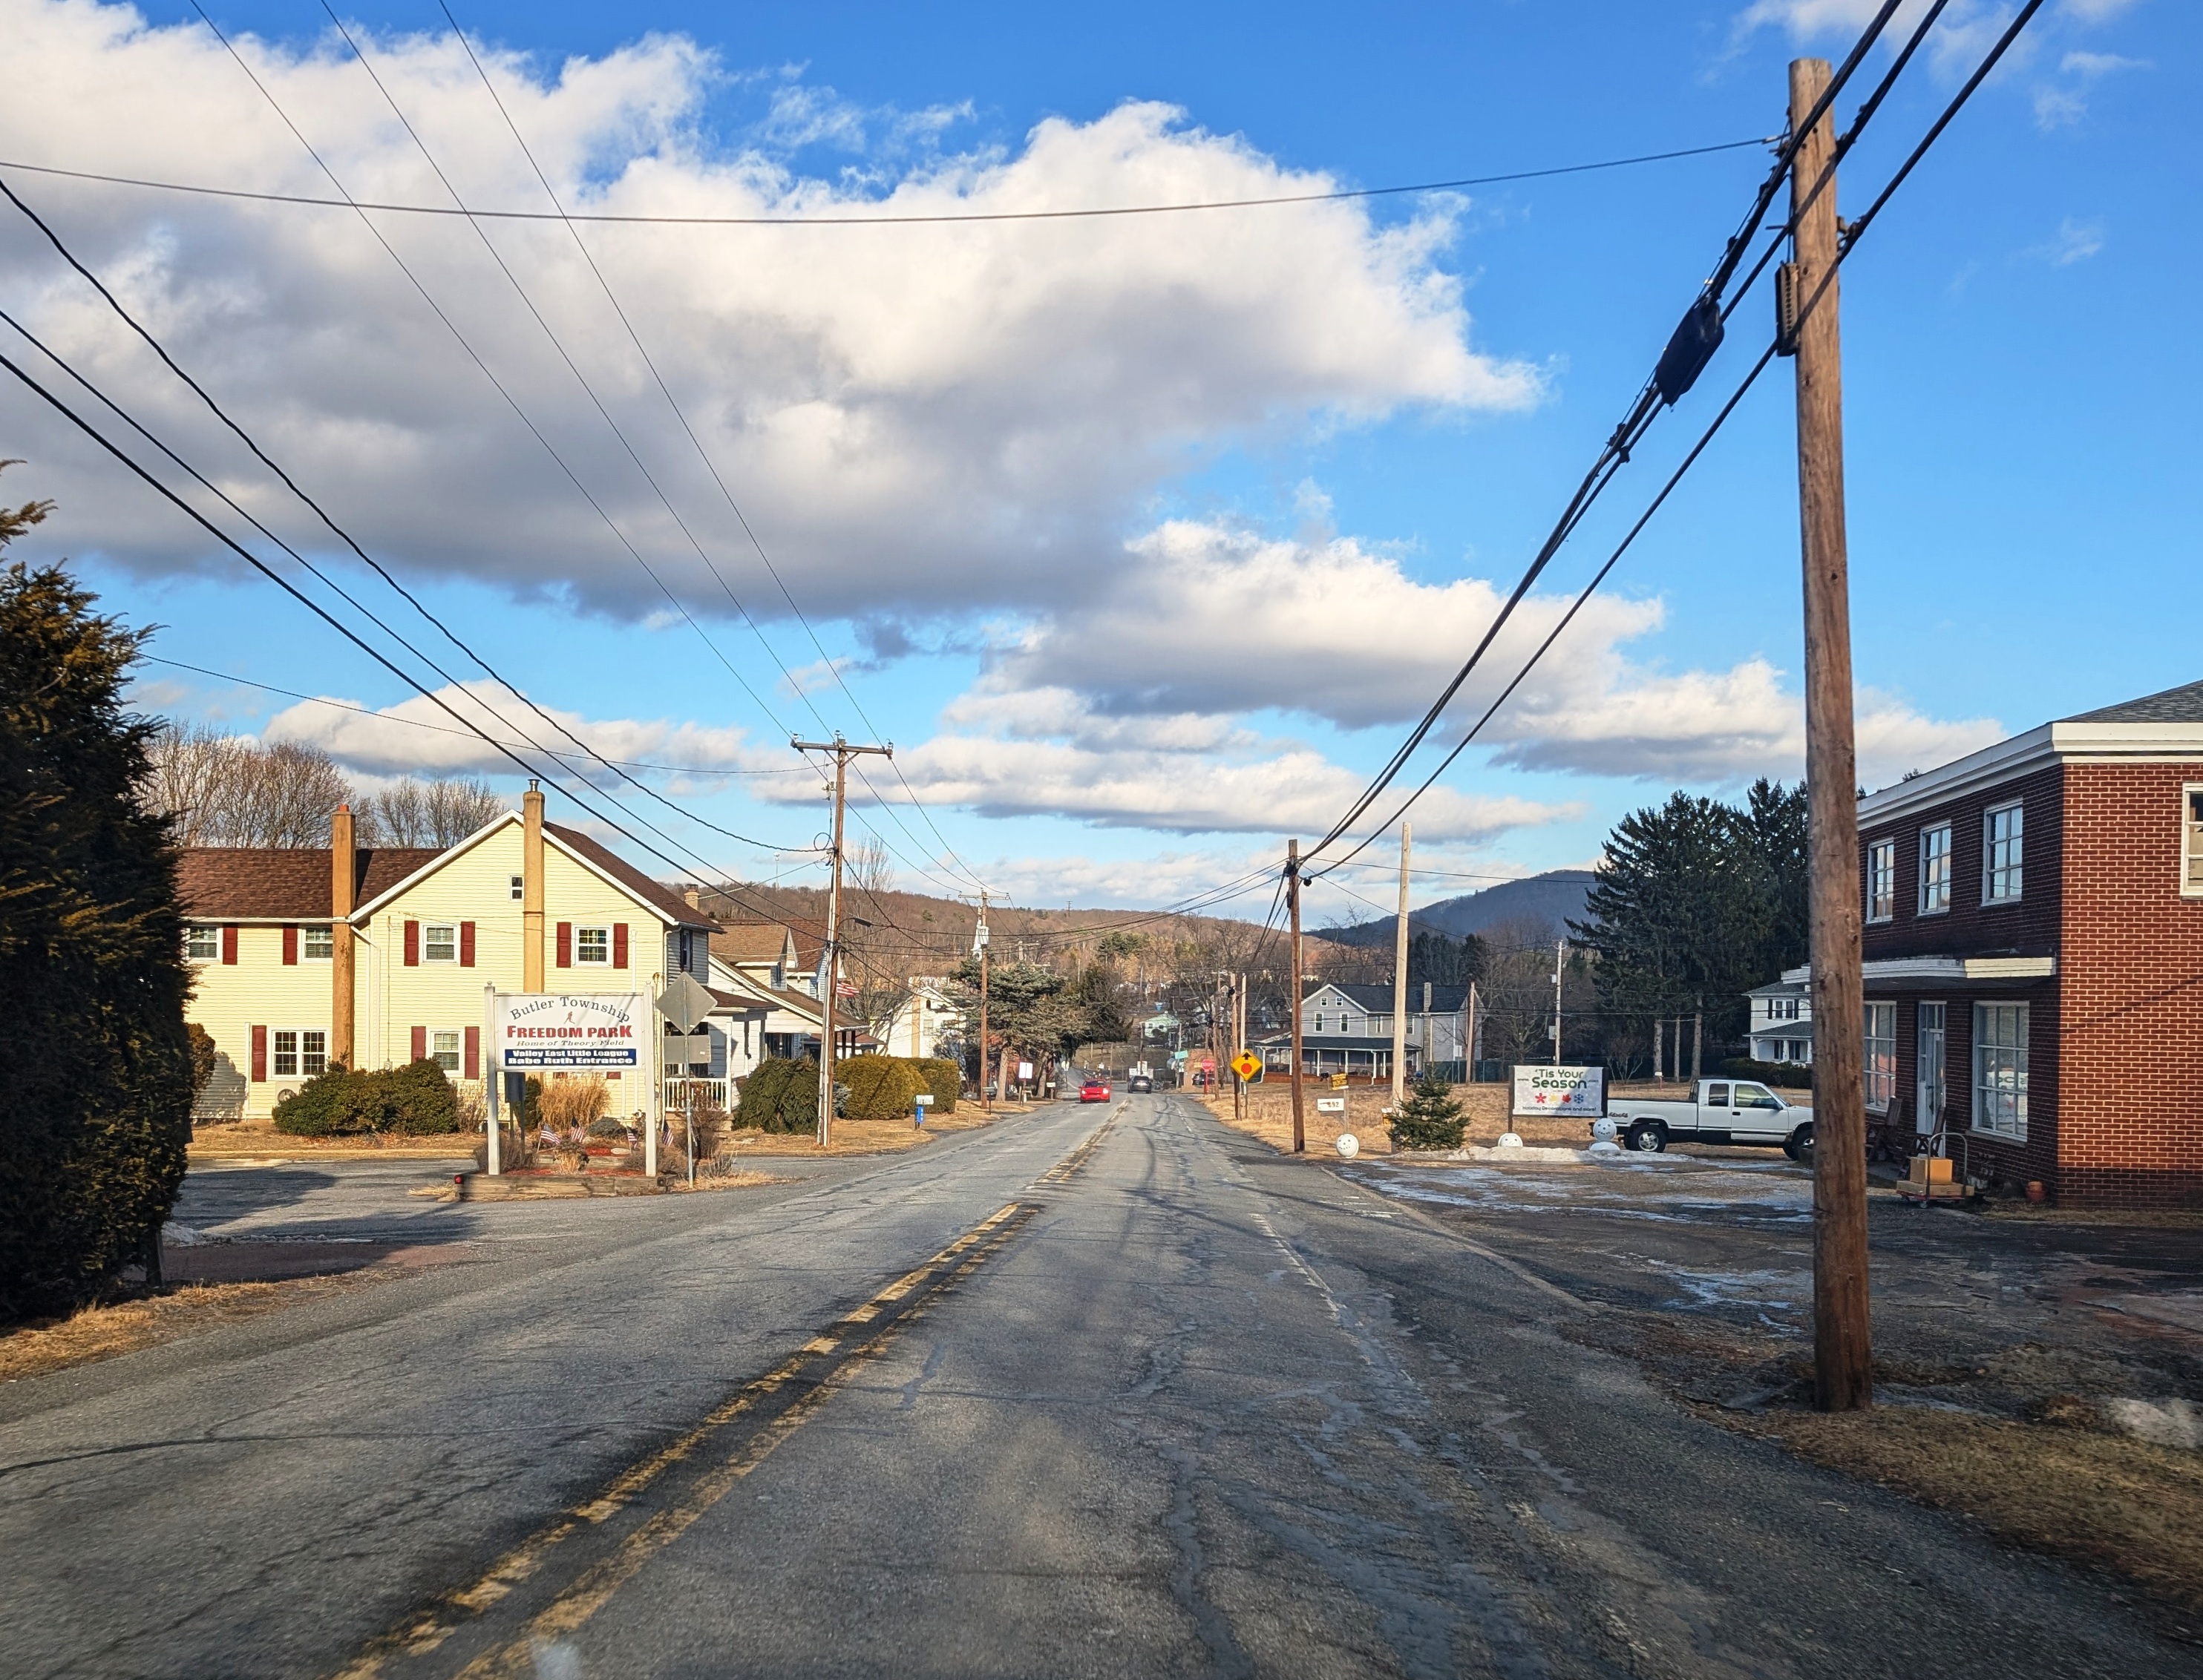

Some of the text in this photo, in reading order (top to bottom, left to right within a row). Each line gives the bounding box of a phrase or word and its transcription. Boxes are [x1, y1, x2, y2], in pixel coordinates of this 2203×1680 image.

[509, 997, 629, 1023] Butler Township
[507, 1025, 633, 1038] FREEDOM PARK
[1557, 1069, 1584, 1078] Your
[1531, 1077, 1587, 1089] Season
